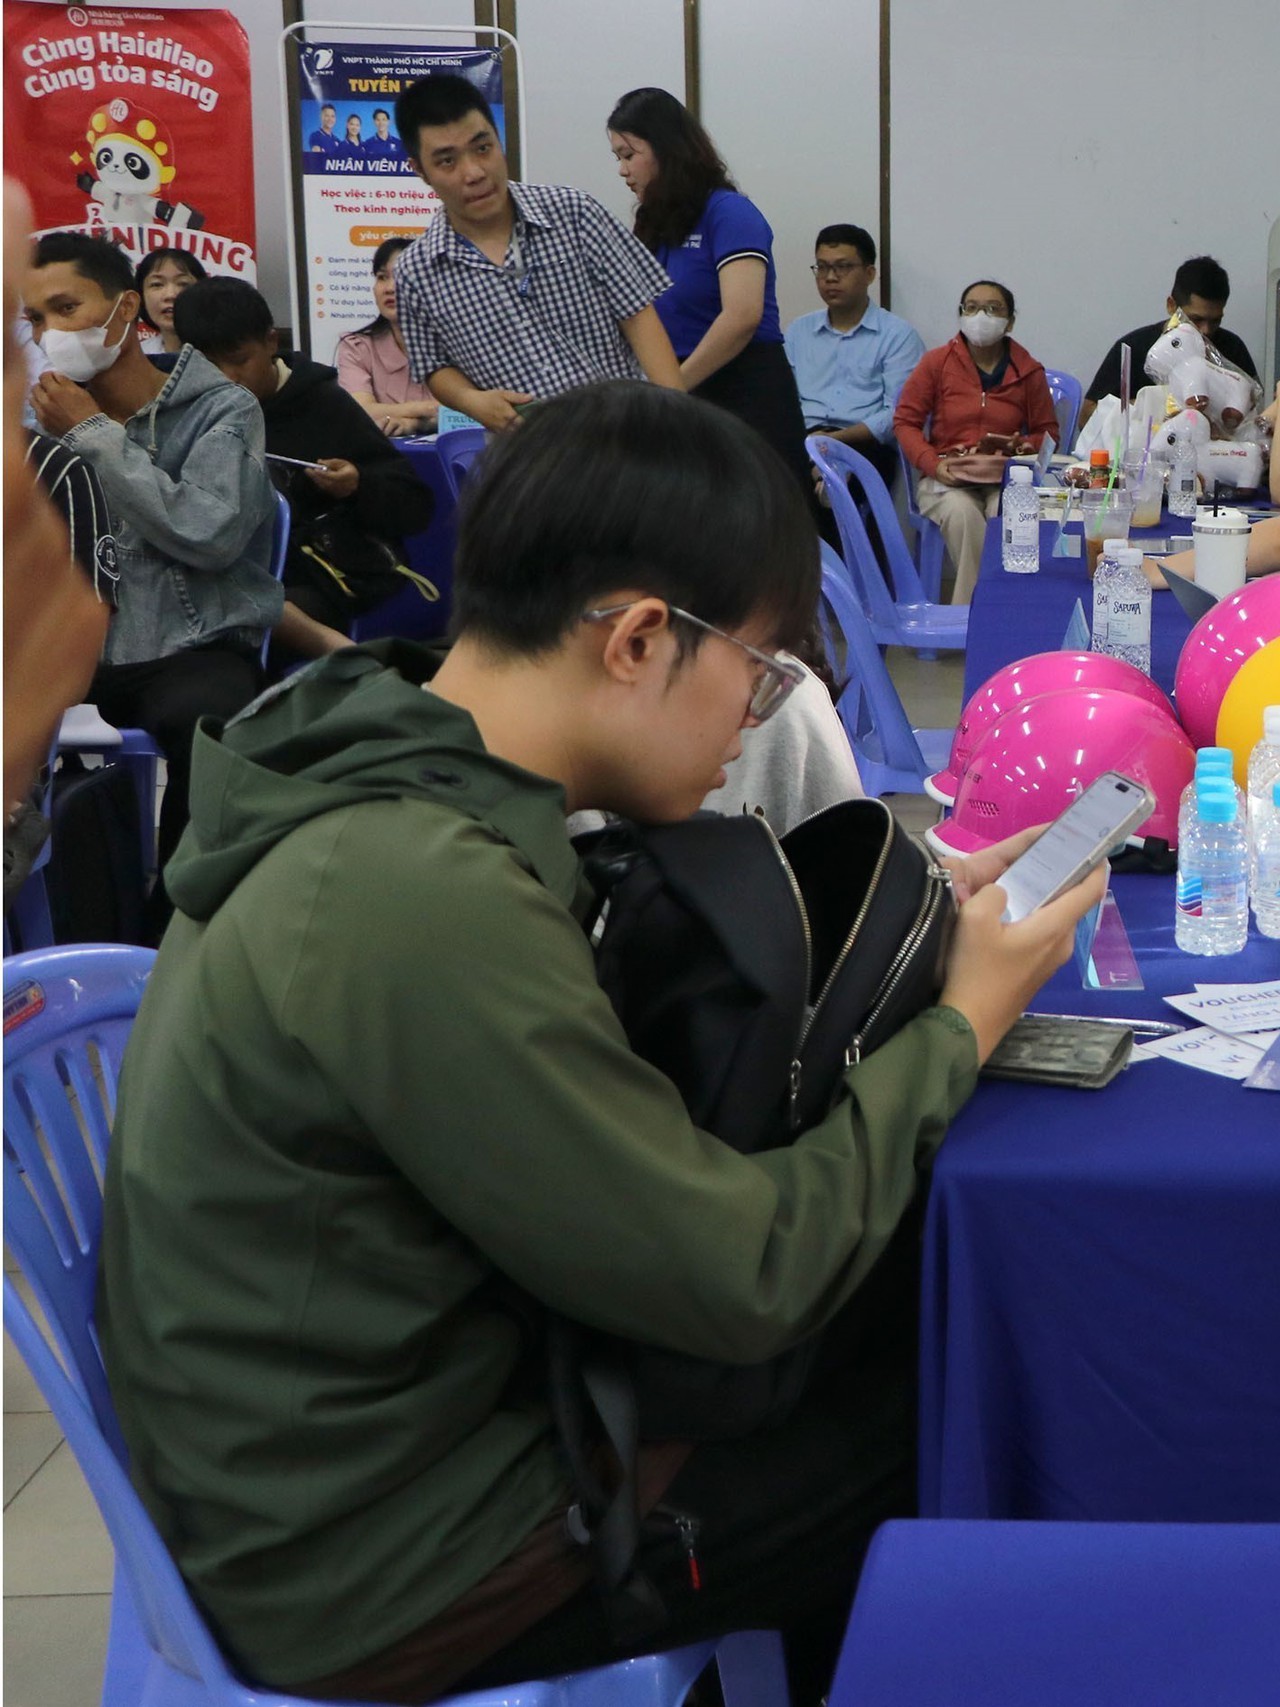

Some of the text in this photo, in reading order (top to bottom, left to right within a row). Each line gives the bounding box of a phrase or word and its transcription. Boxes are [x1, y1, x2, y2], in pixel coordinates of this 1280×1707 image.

[22, 31, 214, 78] Cùng Haidilao
[342, 57, 363, 65] VNPT
[365, 55, 392, 65] THÀNH
[441, 58, 462, 67] MINH
[373, 67, 431, 77] VNPT GIA ĐỊNH
[24, 55, 219, 112] Cùng tỏa sáng
[349, 75, 400, 93] TUYỂN
[325, 158, 363, 171] NHÂN
[367, 158, 398, 172] VIÊN
[321, 189, 341, 199] Học
[345, 189, 366, 200] việc
[375, 190, 396, 199] 6-10
[400, 190, 425, 200] triệu
[334, 204, 361, 213] Theo
[364, 204, 387, 214] kinh
[391, 204, 431, 216] nghiệm
[360, 229, 379, 240] yêu
[331, 311, 355, 319] Nhanh
[1113, 600, 1142, 615] SAPUWA
